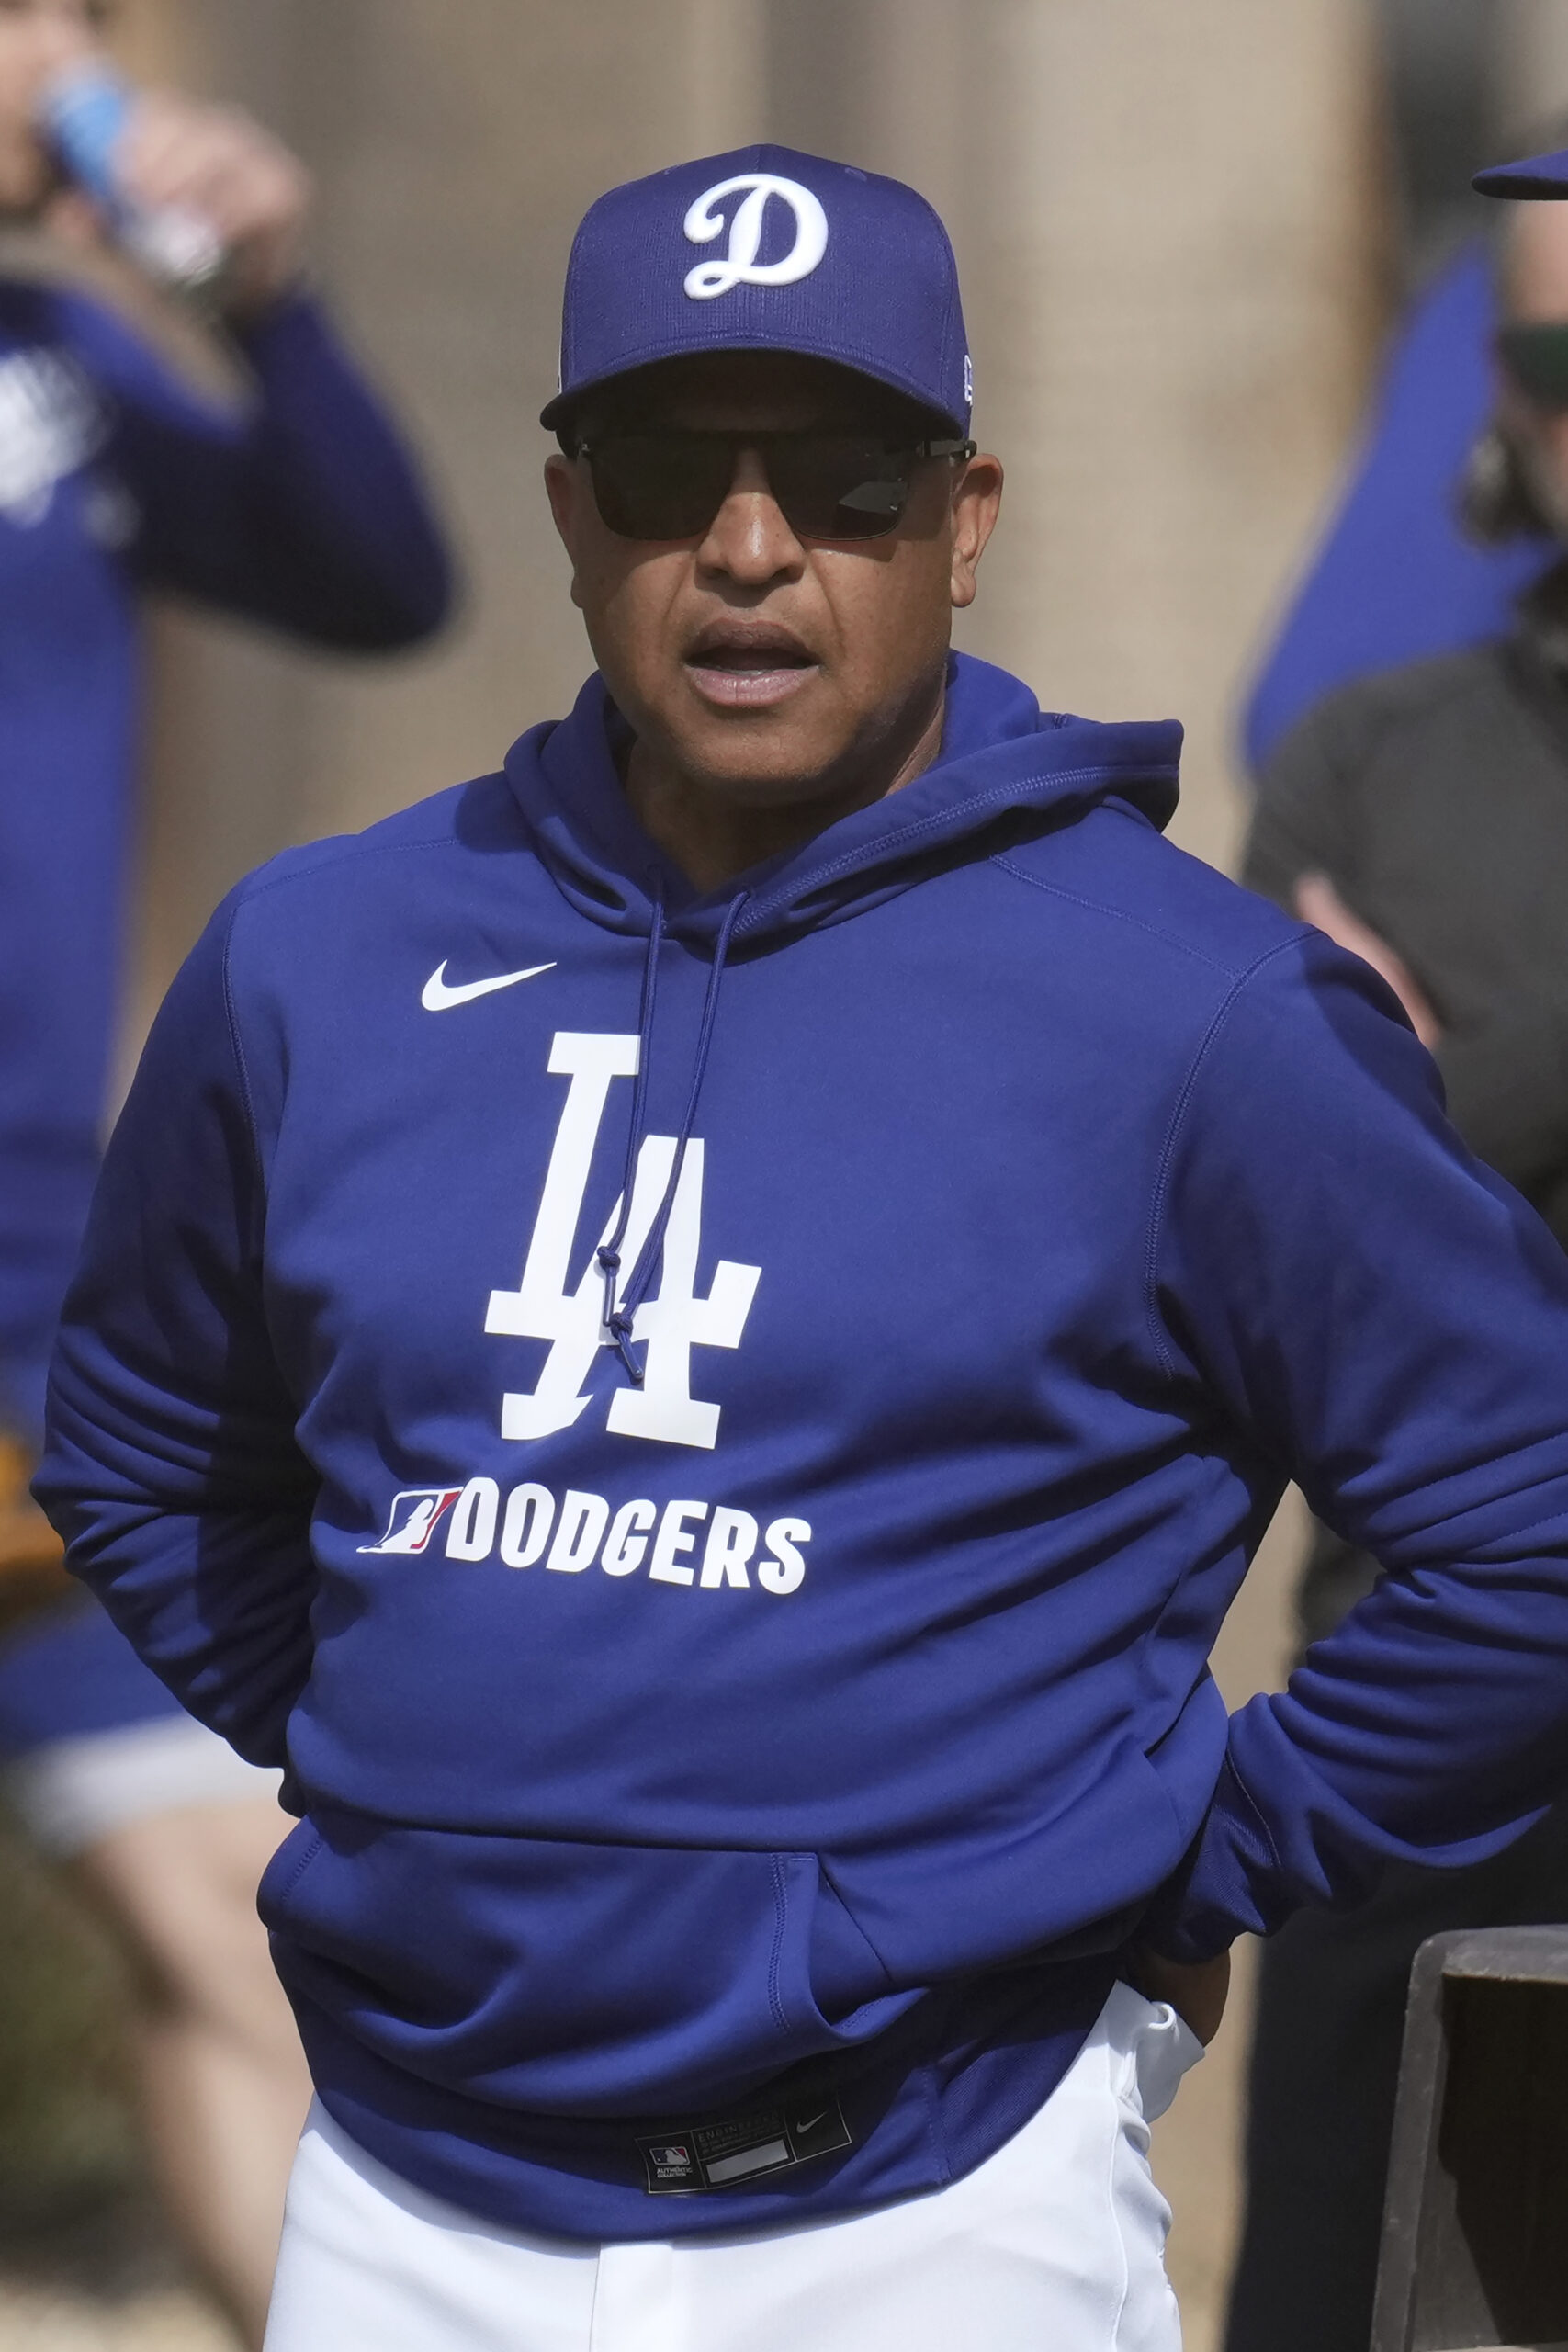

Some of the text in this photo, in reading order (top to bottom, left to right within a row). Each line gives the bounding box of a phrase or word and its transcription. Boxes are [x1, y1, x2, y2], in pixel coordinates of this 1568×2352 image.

[683, 173, 829, 299] D
[484, 1031, 763, 1450] LA
[446, 1476, 813, 1595] DODGERS
